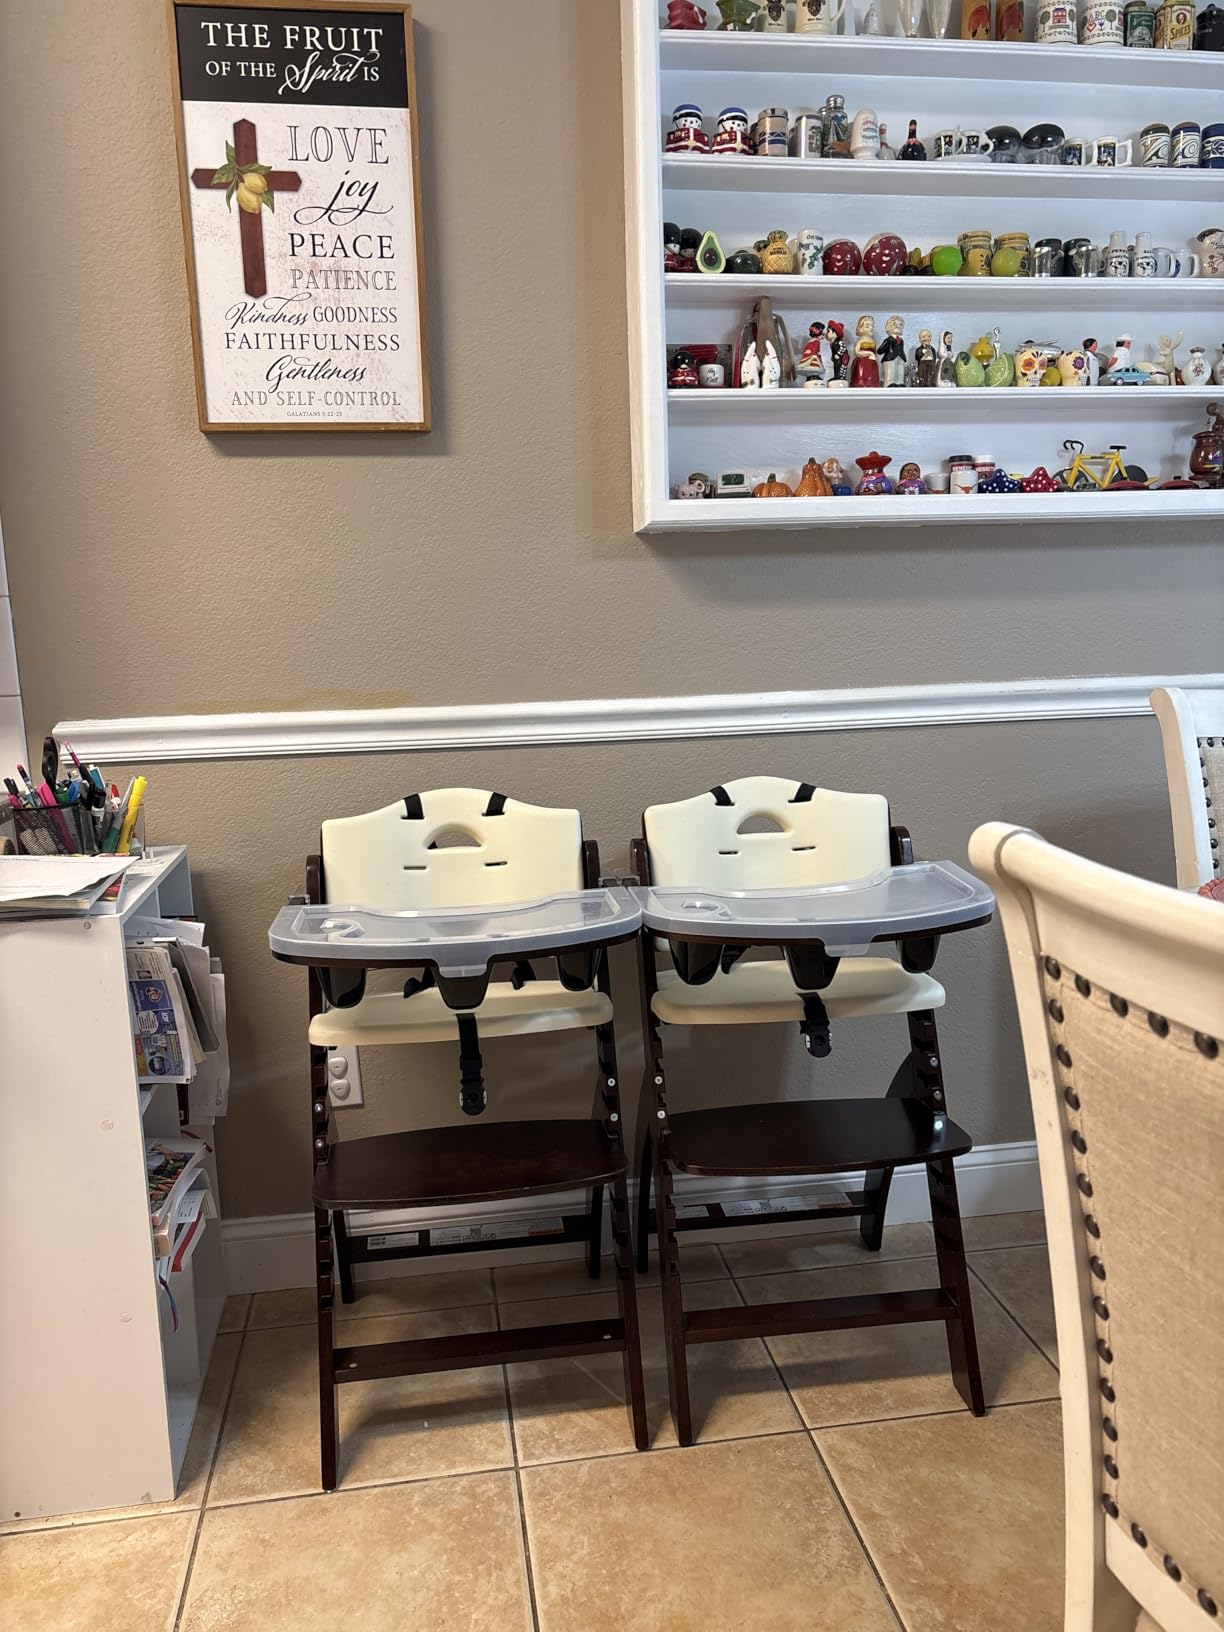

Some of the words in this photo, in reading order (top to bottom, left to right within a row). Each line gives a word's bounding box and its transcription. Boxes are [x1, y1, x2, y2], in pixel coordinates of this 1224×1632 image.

[201, 22, 271, 48] THE
[284, 25, 383, 52] FRUIT
[205, 61, 231, 76] OF
[237, 62, 276, 78] THE
[278, 51, 380, 95] Spirit
[363, 66, 380, 81] IS
[287, 125, 389, 164] LOVE
[293, 170, 393, 226] joy
[288, 232, 395, 259] PEACE
[290, 268, 397, 291] PATIENCE
[224, 292, 312, 330] Kindness
[313, 306, 398, 324] GOODNESS
[224, 332, 400, 351] FAITHFULNESS
[265, 355, 367, 393] Gentleness
[231, 391, 268, 406] AND
[276, 391, 401, 406] SELF-CONTROL
